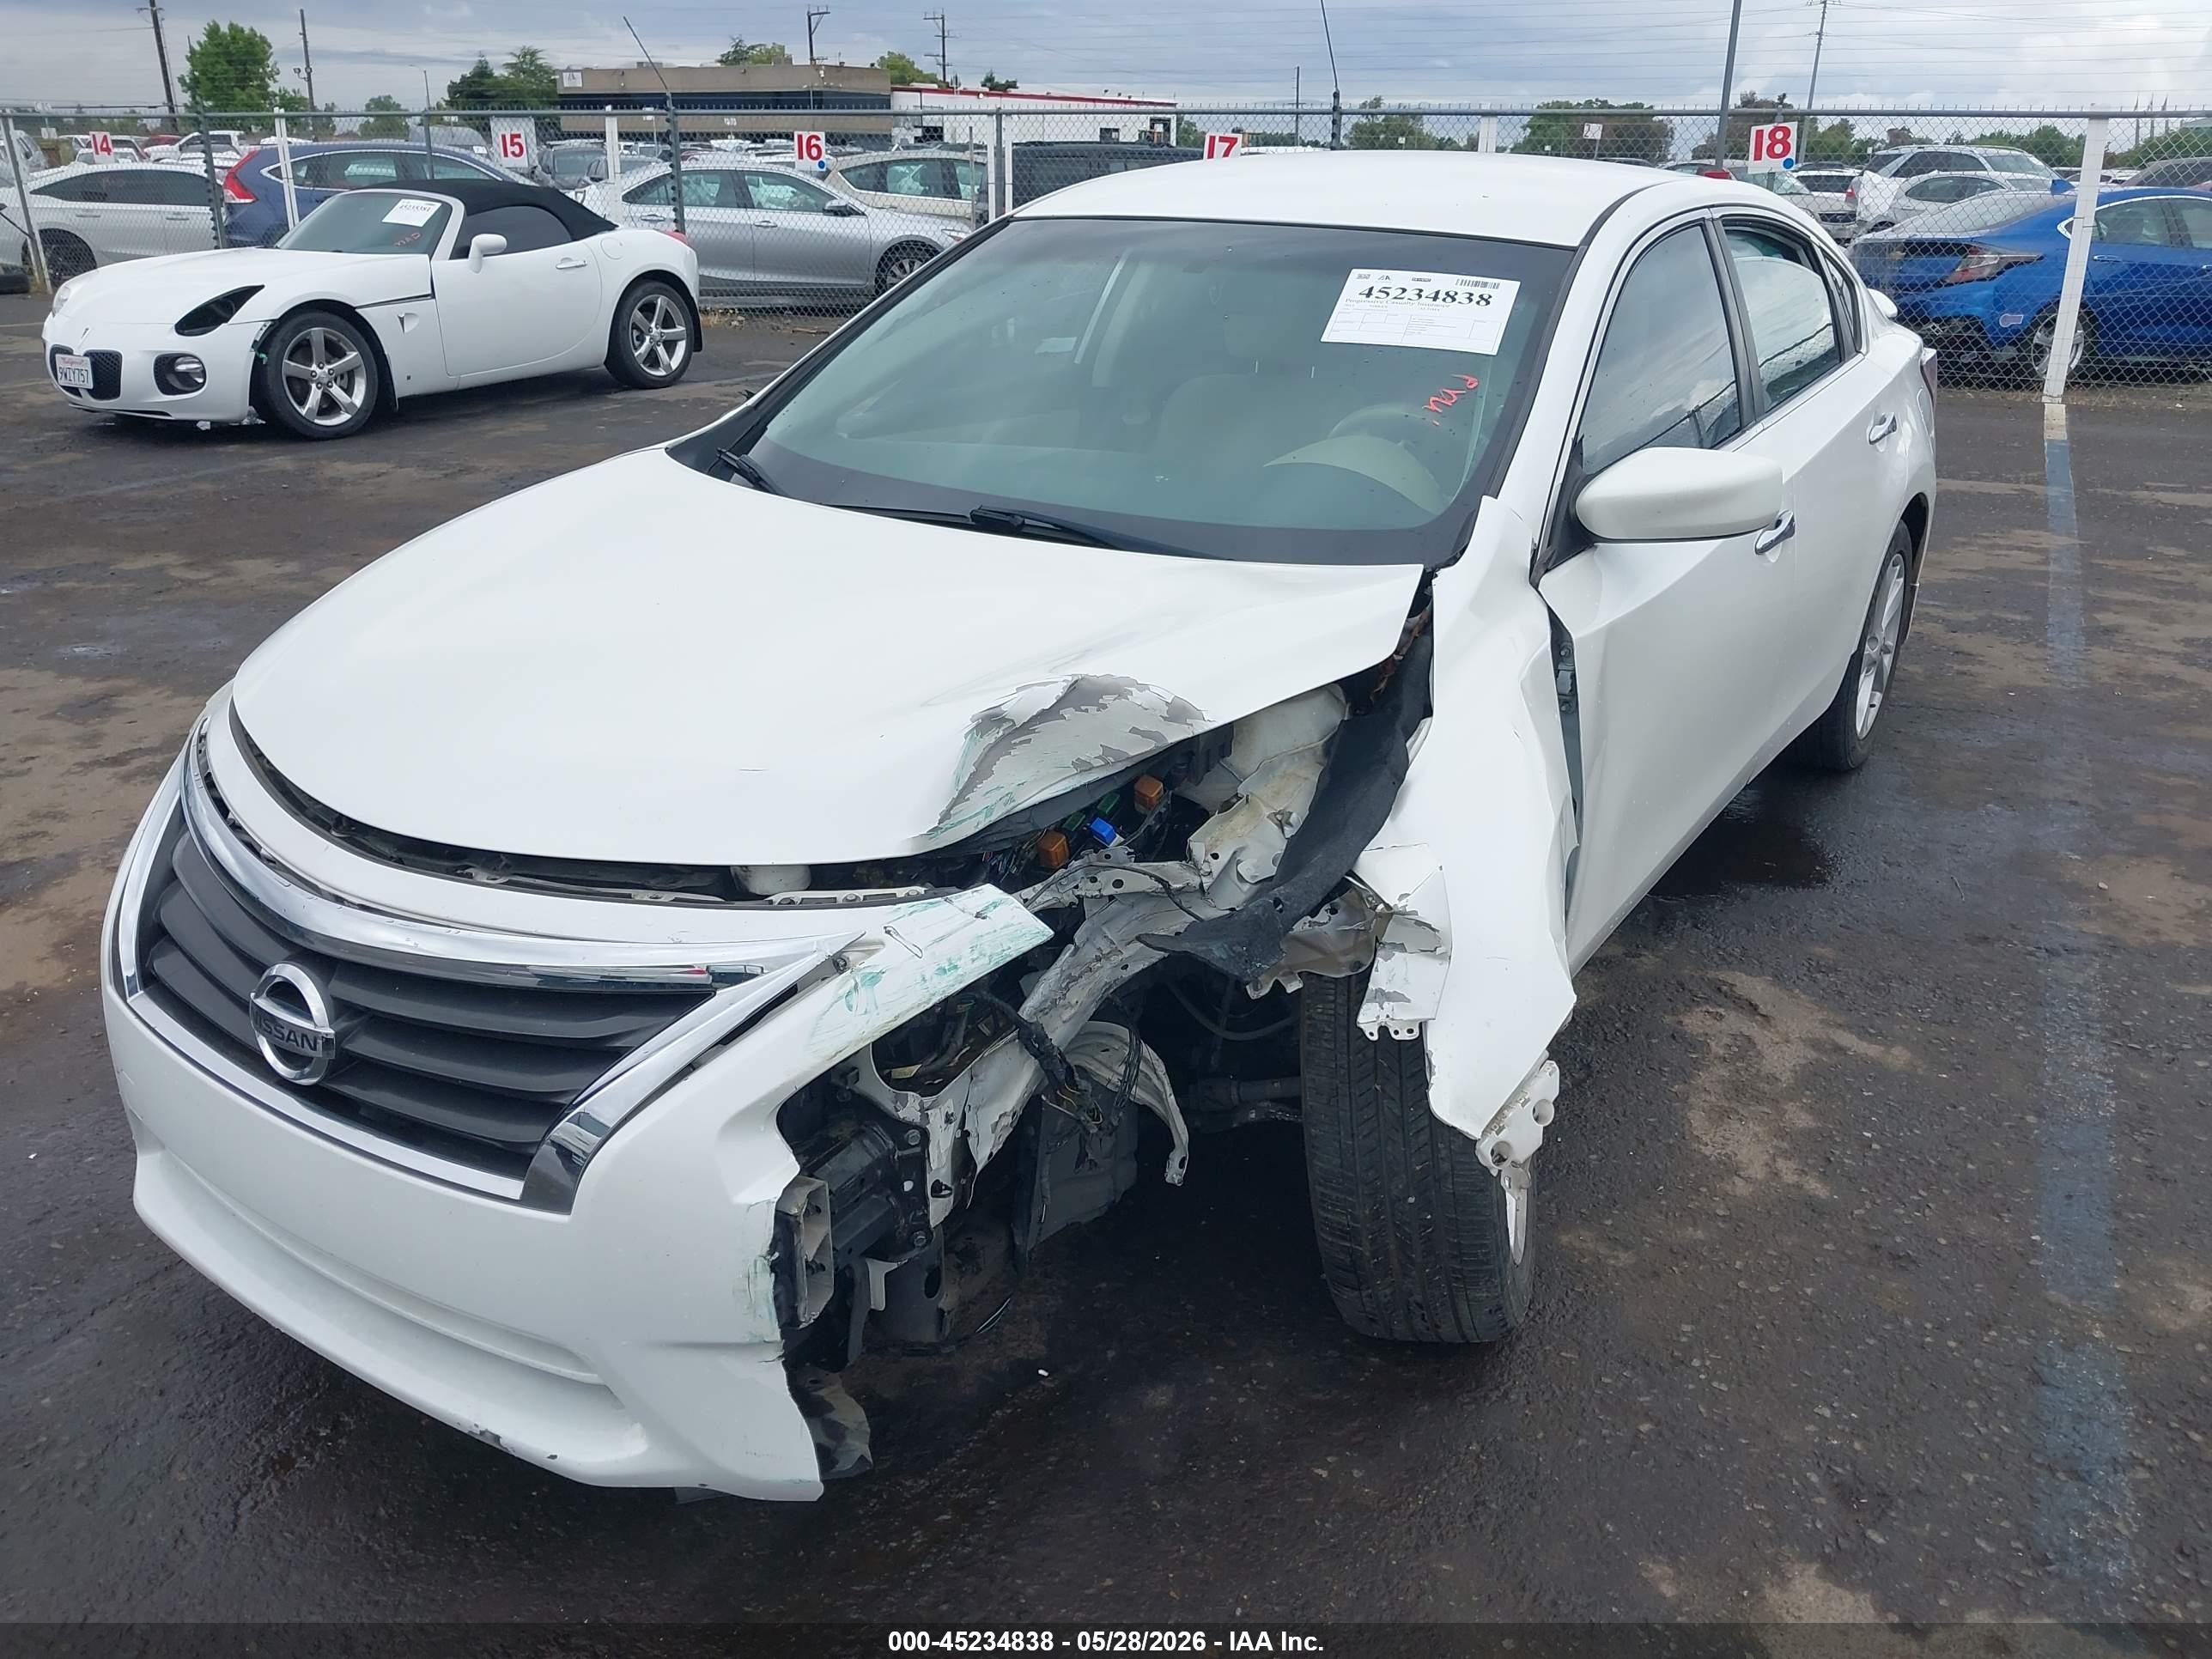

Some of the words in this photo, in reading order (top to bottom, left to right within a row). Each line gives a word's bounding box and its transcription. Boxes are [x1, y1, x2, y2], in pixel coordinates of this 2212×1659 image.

[92, 133, 112, 155] 14
[501, 133, 524, 158] 15
[797, 134, 822, 161] 16
[1206, 135, 1238, 159] 17
[1753, 125, 1791, 161] 18
[1358, 285, 1493, 307] 45234838
